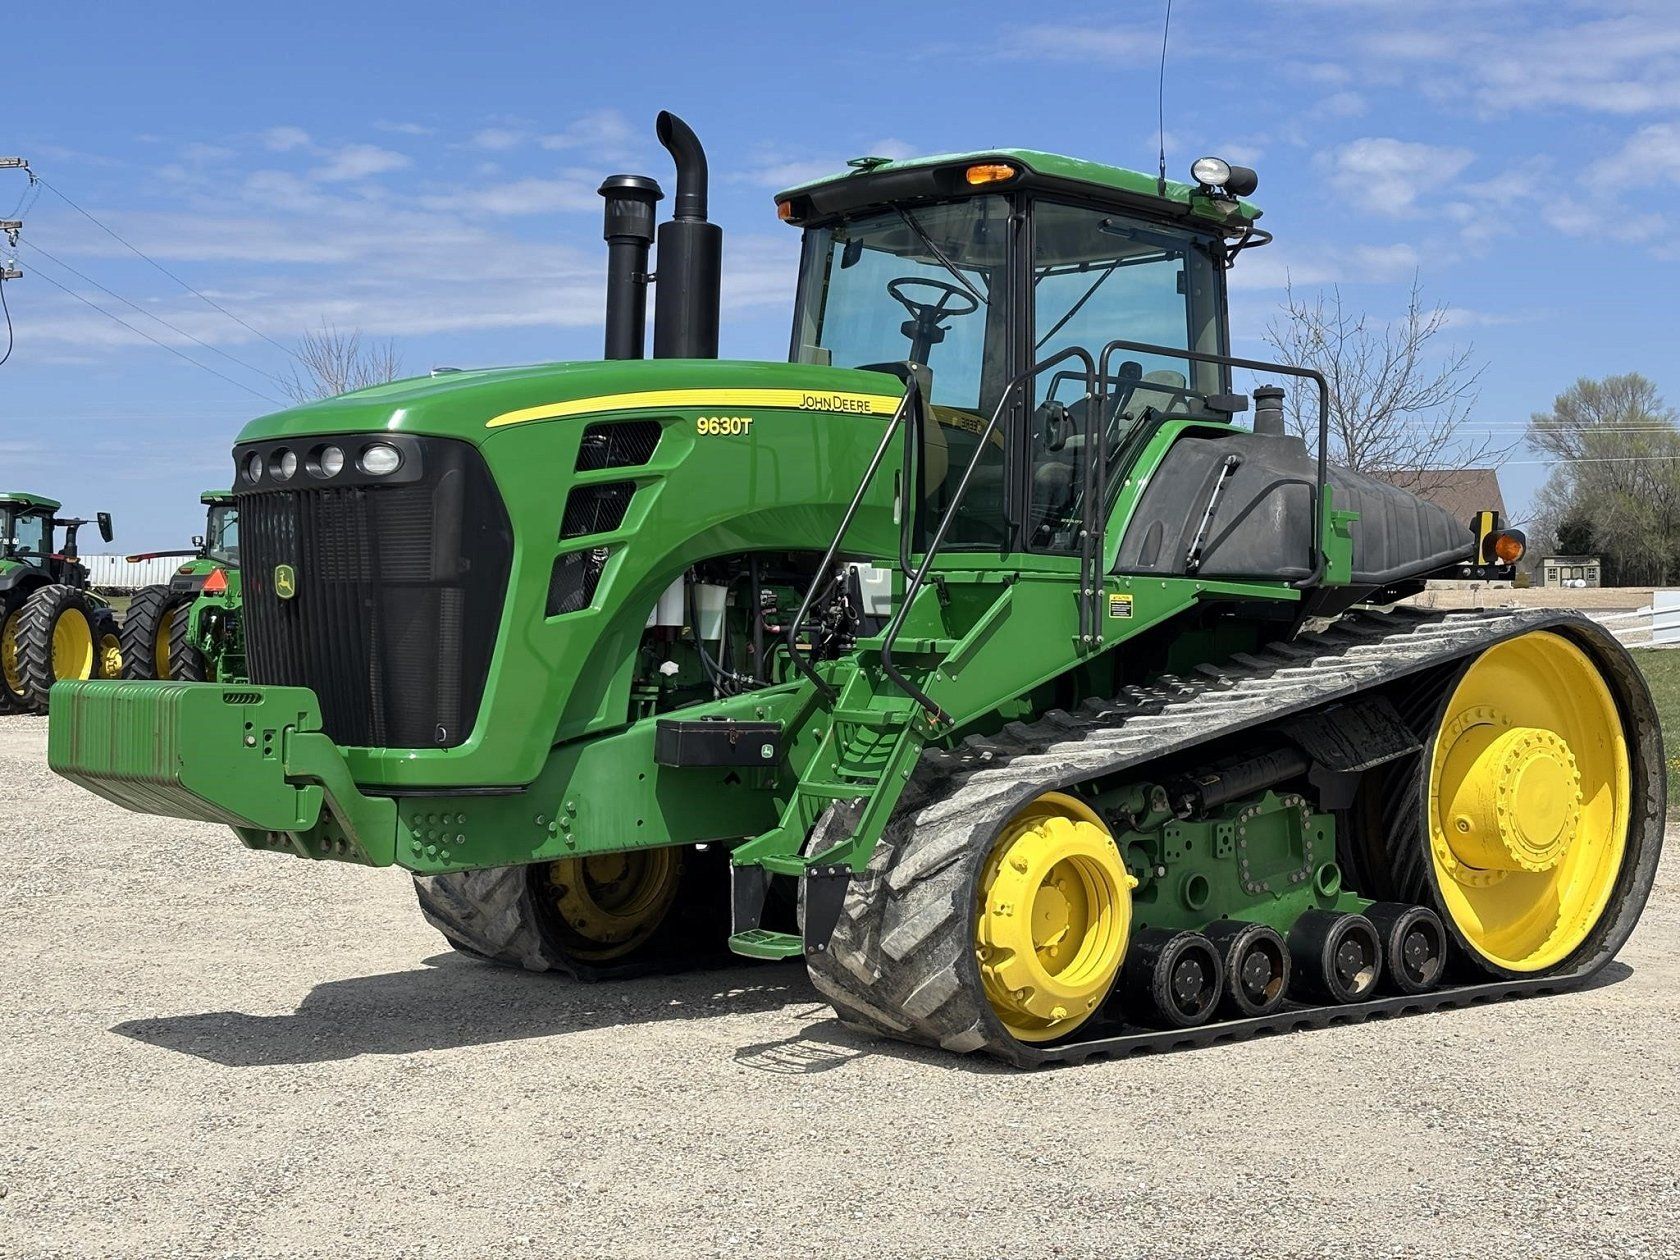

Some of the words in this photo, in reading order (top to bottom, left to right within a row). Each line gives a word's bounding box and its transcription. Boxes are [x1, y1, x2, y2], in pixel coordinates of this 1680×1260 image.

[799, 393, 831, 409] JOHN
[833, 395, 871, 412] DEERE
[697, 416, 754, 436] 9630T
